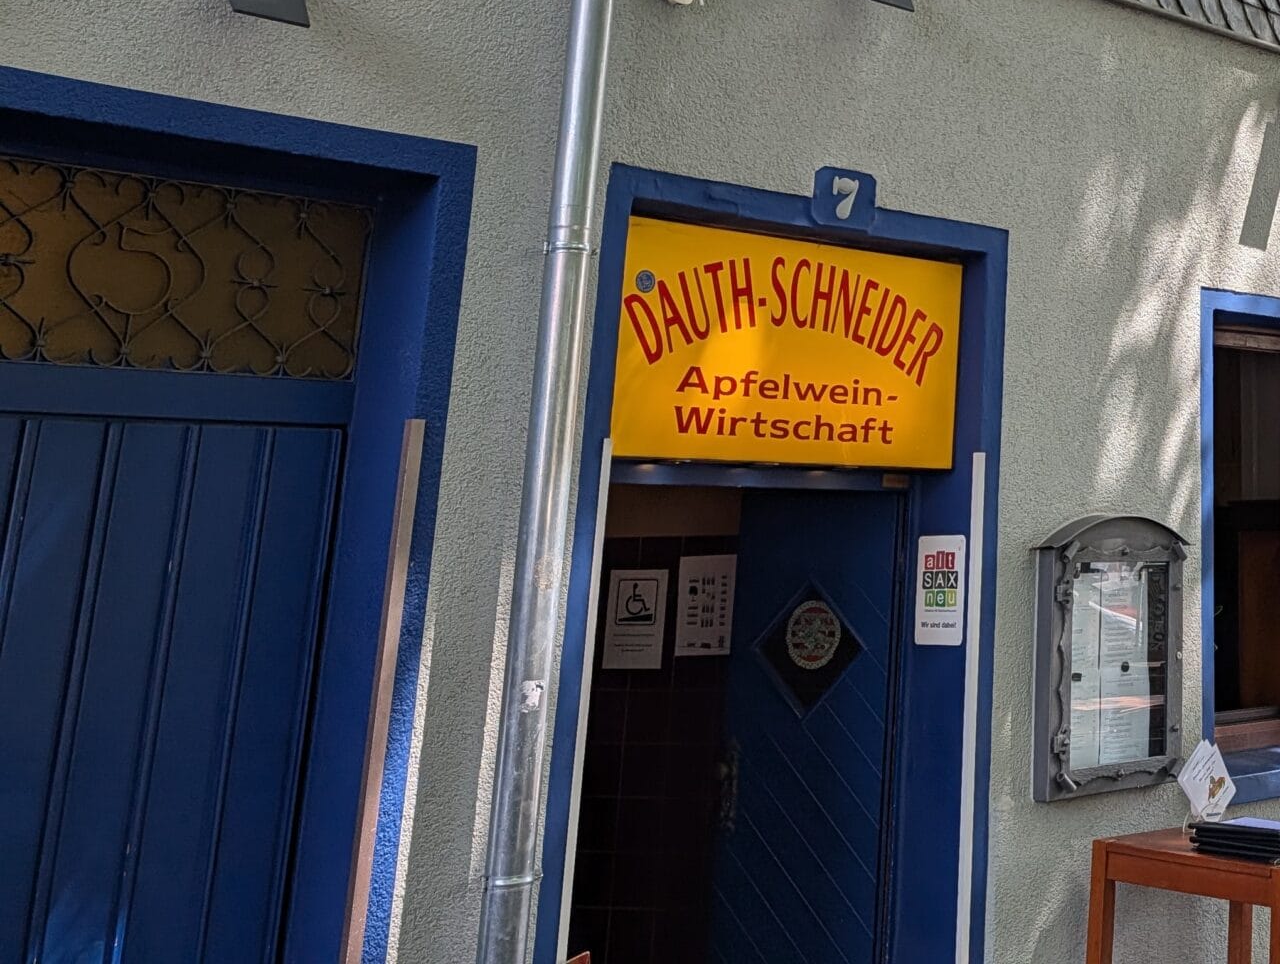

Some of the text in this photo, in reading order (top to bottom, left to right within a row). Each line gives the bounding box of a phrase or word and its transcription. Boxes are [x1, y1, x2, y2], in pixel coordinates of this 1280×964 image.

[832, 175, 860, 220] 7
[623, 256, 944, 387] DAUTH-SCHNEIDER
[676, 365, 899, 407] Apfelwein-
[673, 405, 894, 445] Wirtschaft
[924, 572, 957, 588] SAX
[926, 553, 954, 568] alt
[926, 591, 955, 605] neu
